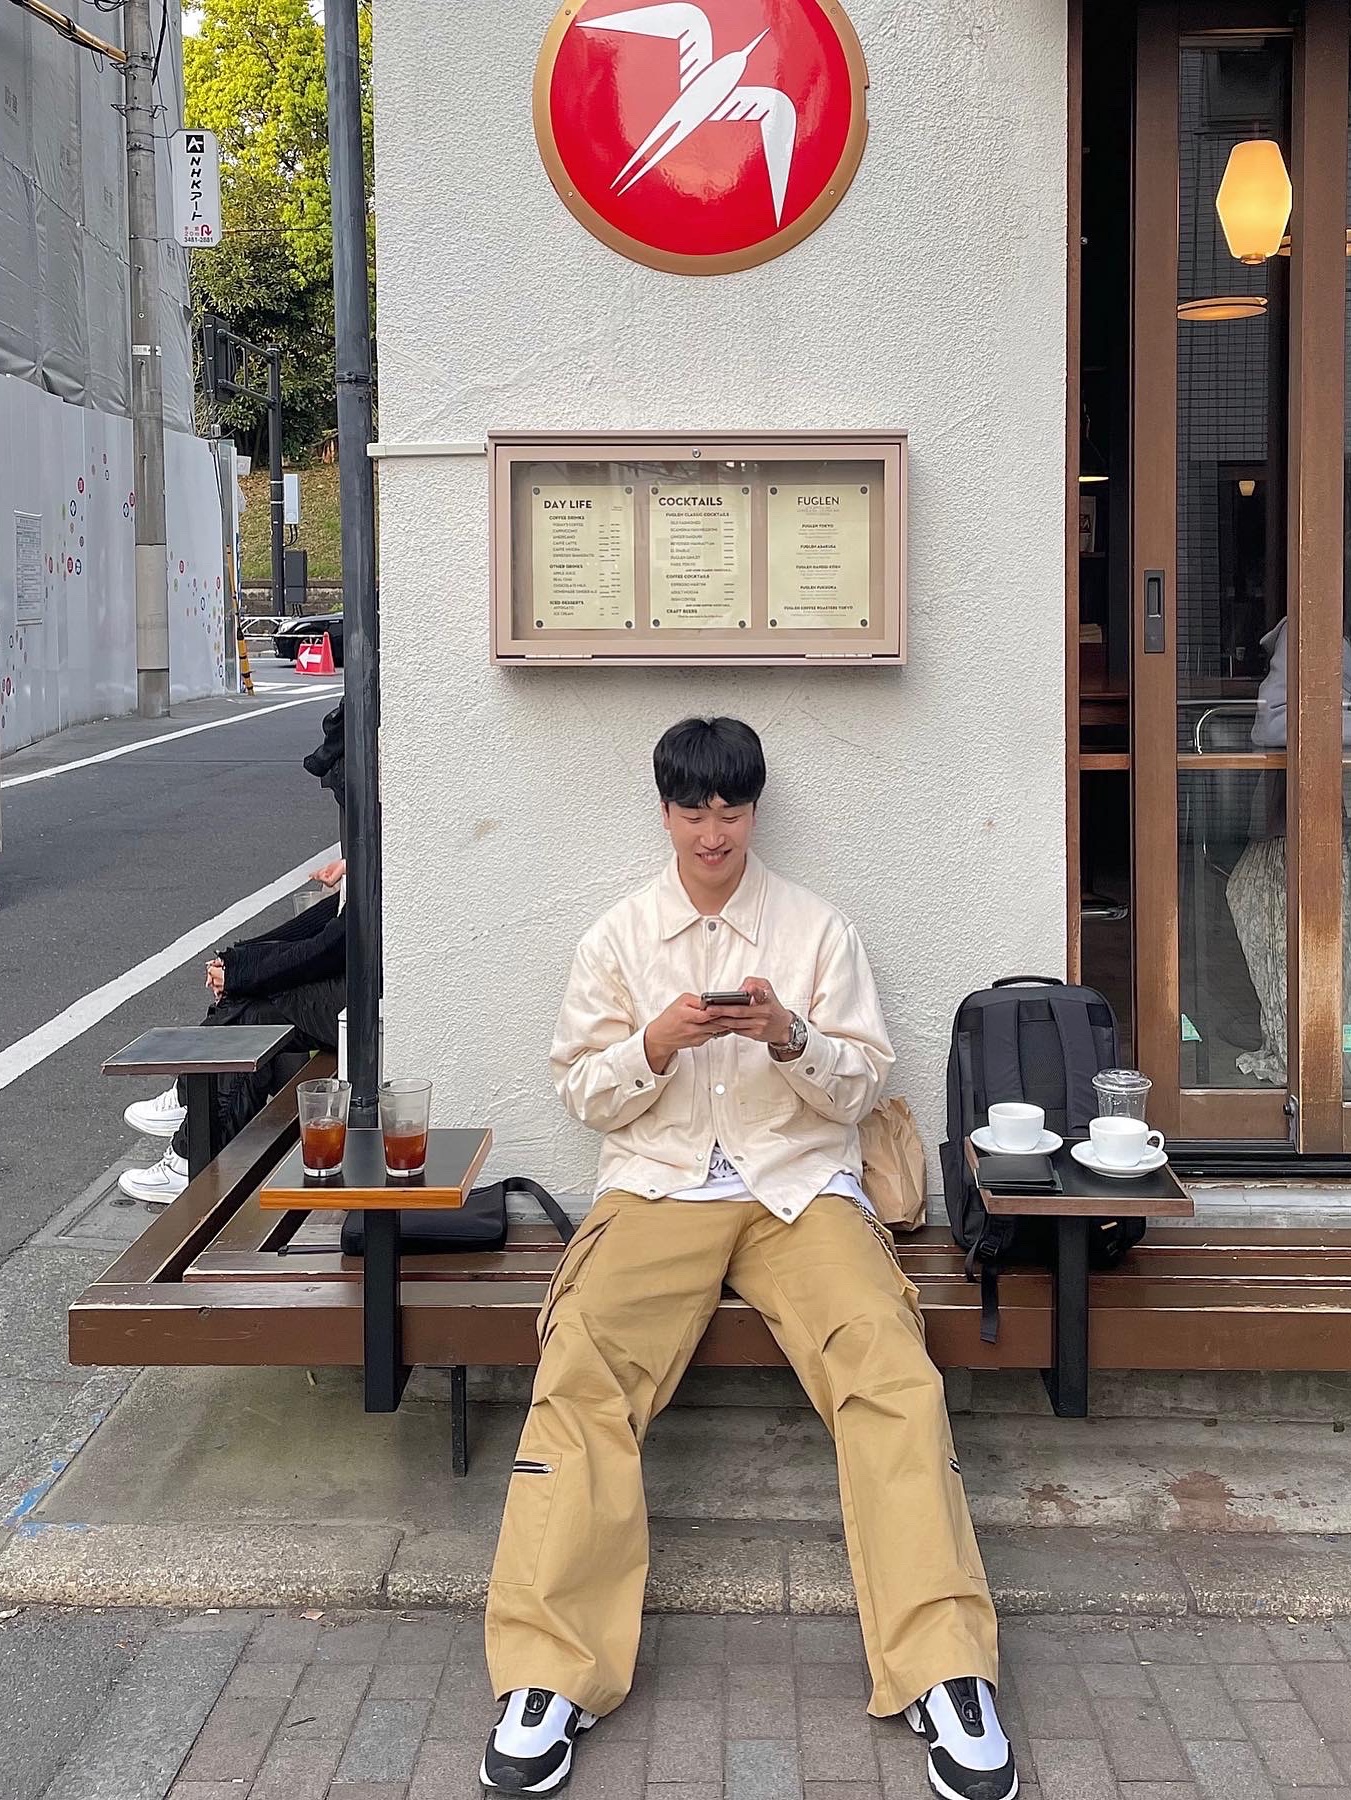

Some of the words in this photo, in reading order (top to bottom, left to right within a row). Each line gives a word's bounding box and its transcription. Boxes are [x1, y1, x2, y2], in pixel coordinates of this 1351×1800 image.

[190, 156, 203, 221] NHKアート
[543, 500, 567, 509] DAY
[569, 500, 593, 509] LIFE
[658, 497, 723, 506] COCKTAILS
[797, 496, 840, 506] FUGLEN
